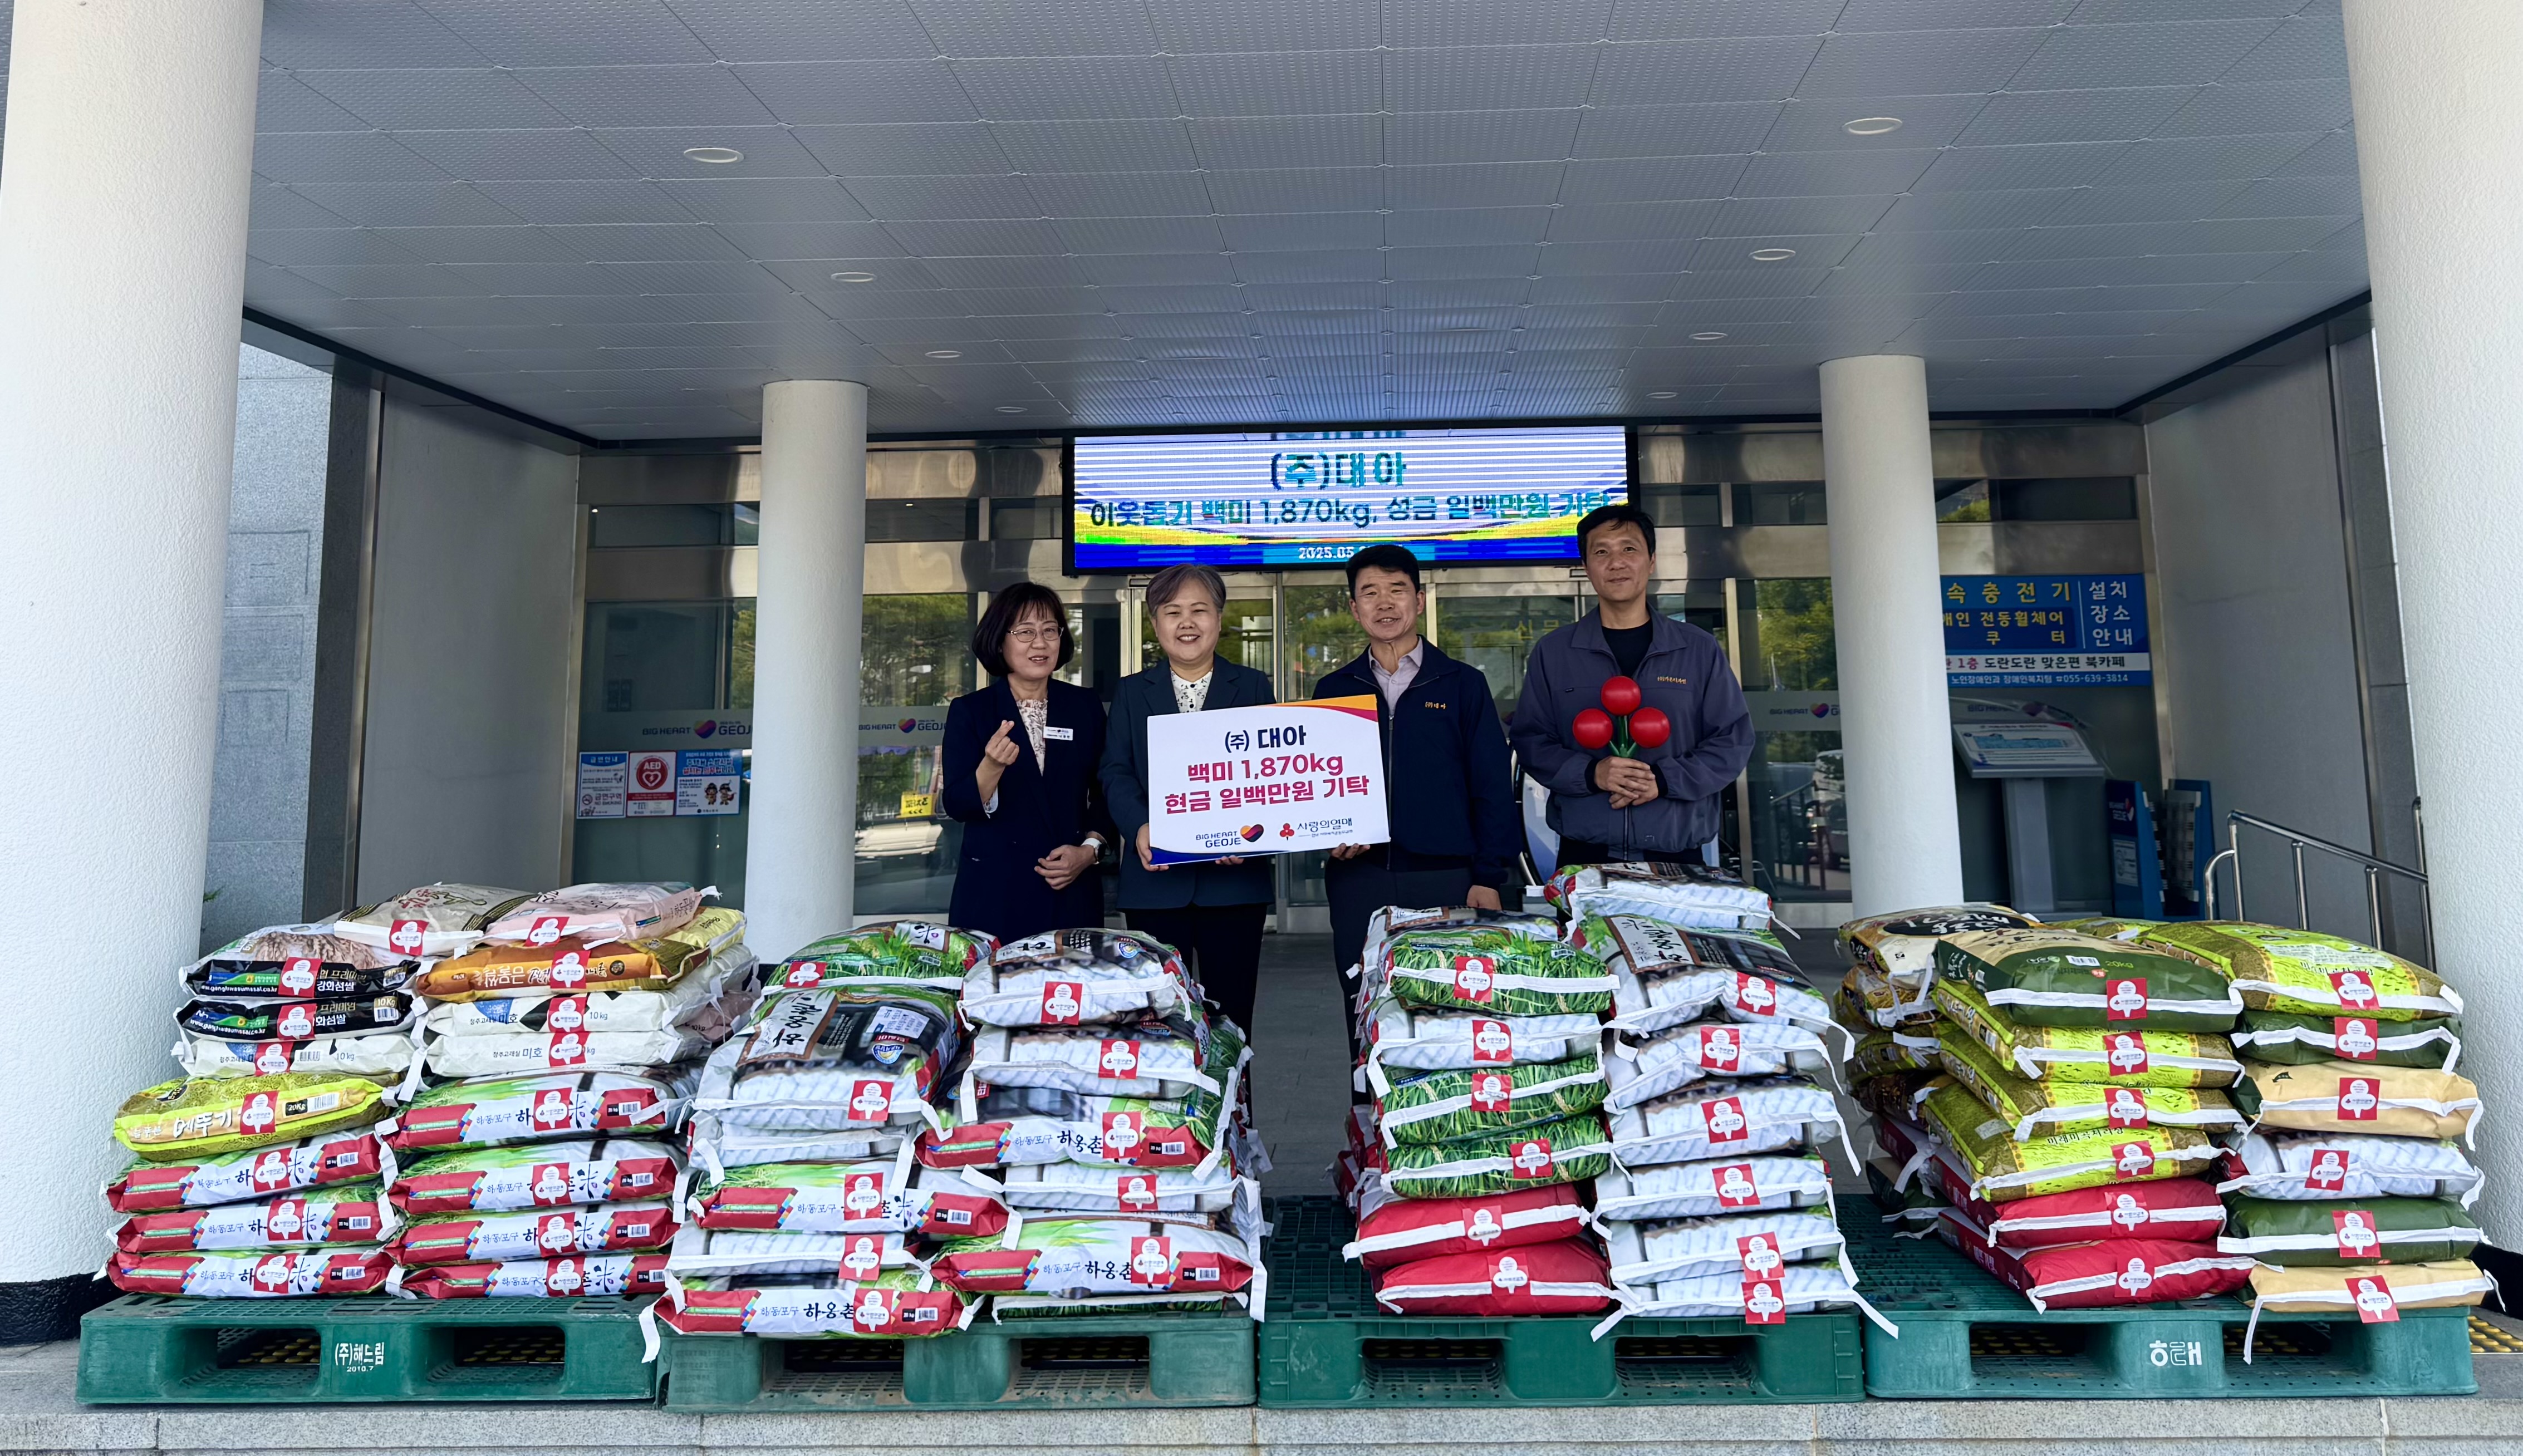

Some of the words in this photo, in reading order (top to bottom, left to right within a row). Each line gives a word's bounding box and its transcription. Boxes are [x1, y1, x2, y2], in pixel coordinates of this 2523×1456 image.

[1271, 451, 1407, 490] (주)대아
[1201, 500, 1251, 525] 백미
[1386, 496, 1436, 520] 성금
[1447, 493, 1549, 520] 일백만원
[2089, 581, 2127, 600] 설치
[2091, 605, 2131, 624] 장소
[2092, 628, 2133, 647] 안내
[1985, 657, 2036, 669] 도란도란
[2085, 656, 2126, 668] 북카페
[2063, 674, 2128, 683] 055-639-3814
[719, 725, 751, 735] GEOJ
[918, 722, 945, 731] GEOJ
[1225, 730, 1250, 753] (주)
[1258, 725, 1307, 749] 대아
[643, 761, 661, 770] AED
[1187, 760, 1233, 783] 백미
[1241, 752, 1343, 780] 1,870kg
[1165, 790, 1211, 815] 현금
[1219, 779, 1315, 809] 일백만원
[1323, 775, 1370, 799] 기탁
[1297, 817, 1353, 833] 사랑의열매
[1211, 830, 1238, 839] HEART
[1205, 838, 1241, 848] GEOJE
[316, 981, 355, 991] 강화섬쌀
[321, 1002, 356, 1011] 프리미엄
[313, 1014, 346, 1026] 화섬쌀
[600, 1011, 608, 1020] kg
[522, 1047, 543, 1059] 미호
[173, 1108, 233, 1138] 메뚜기
